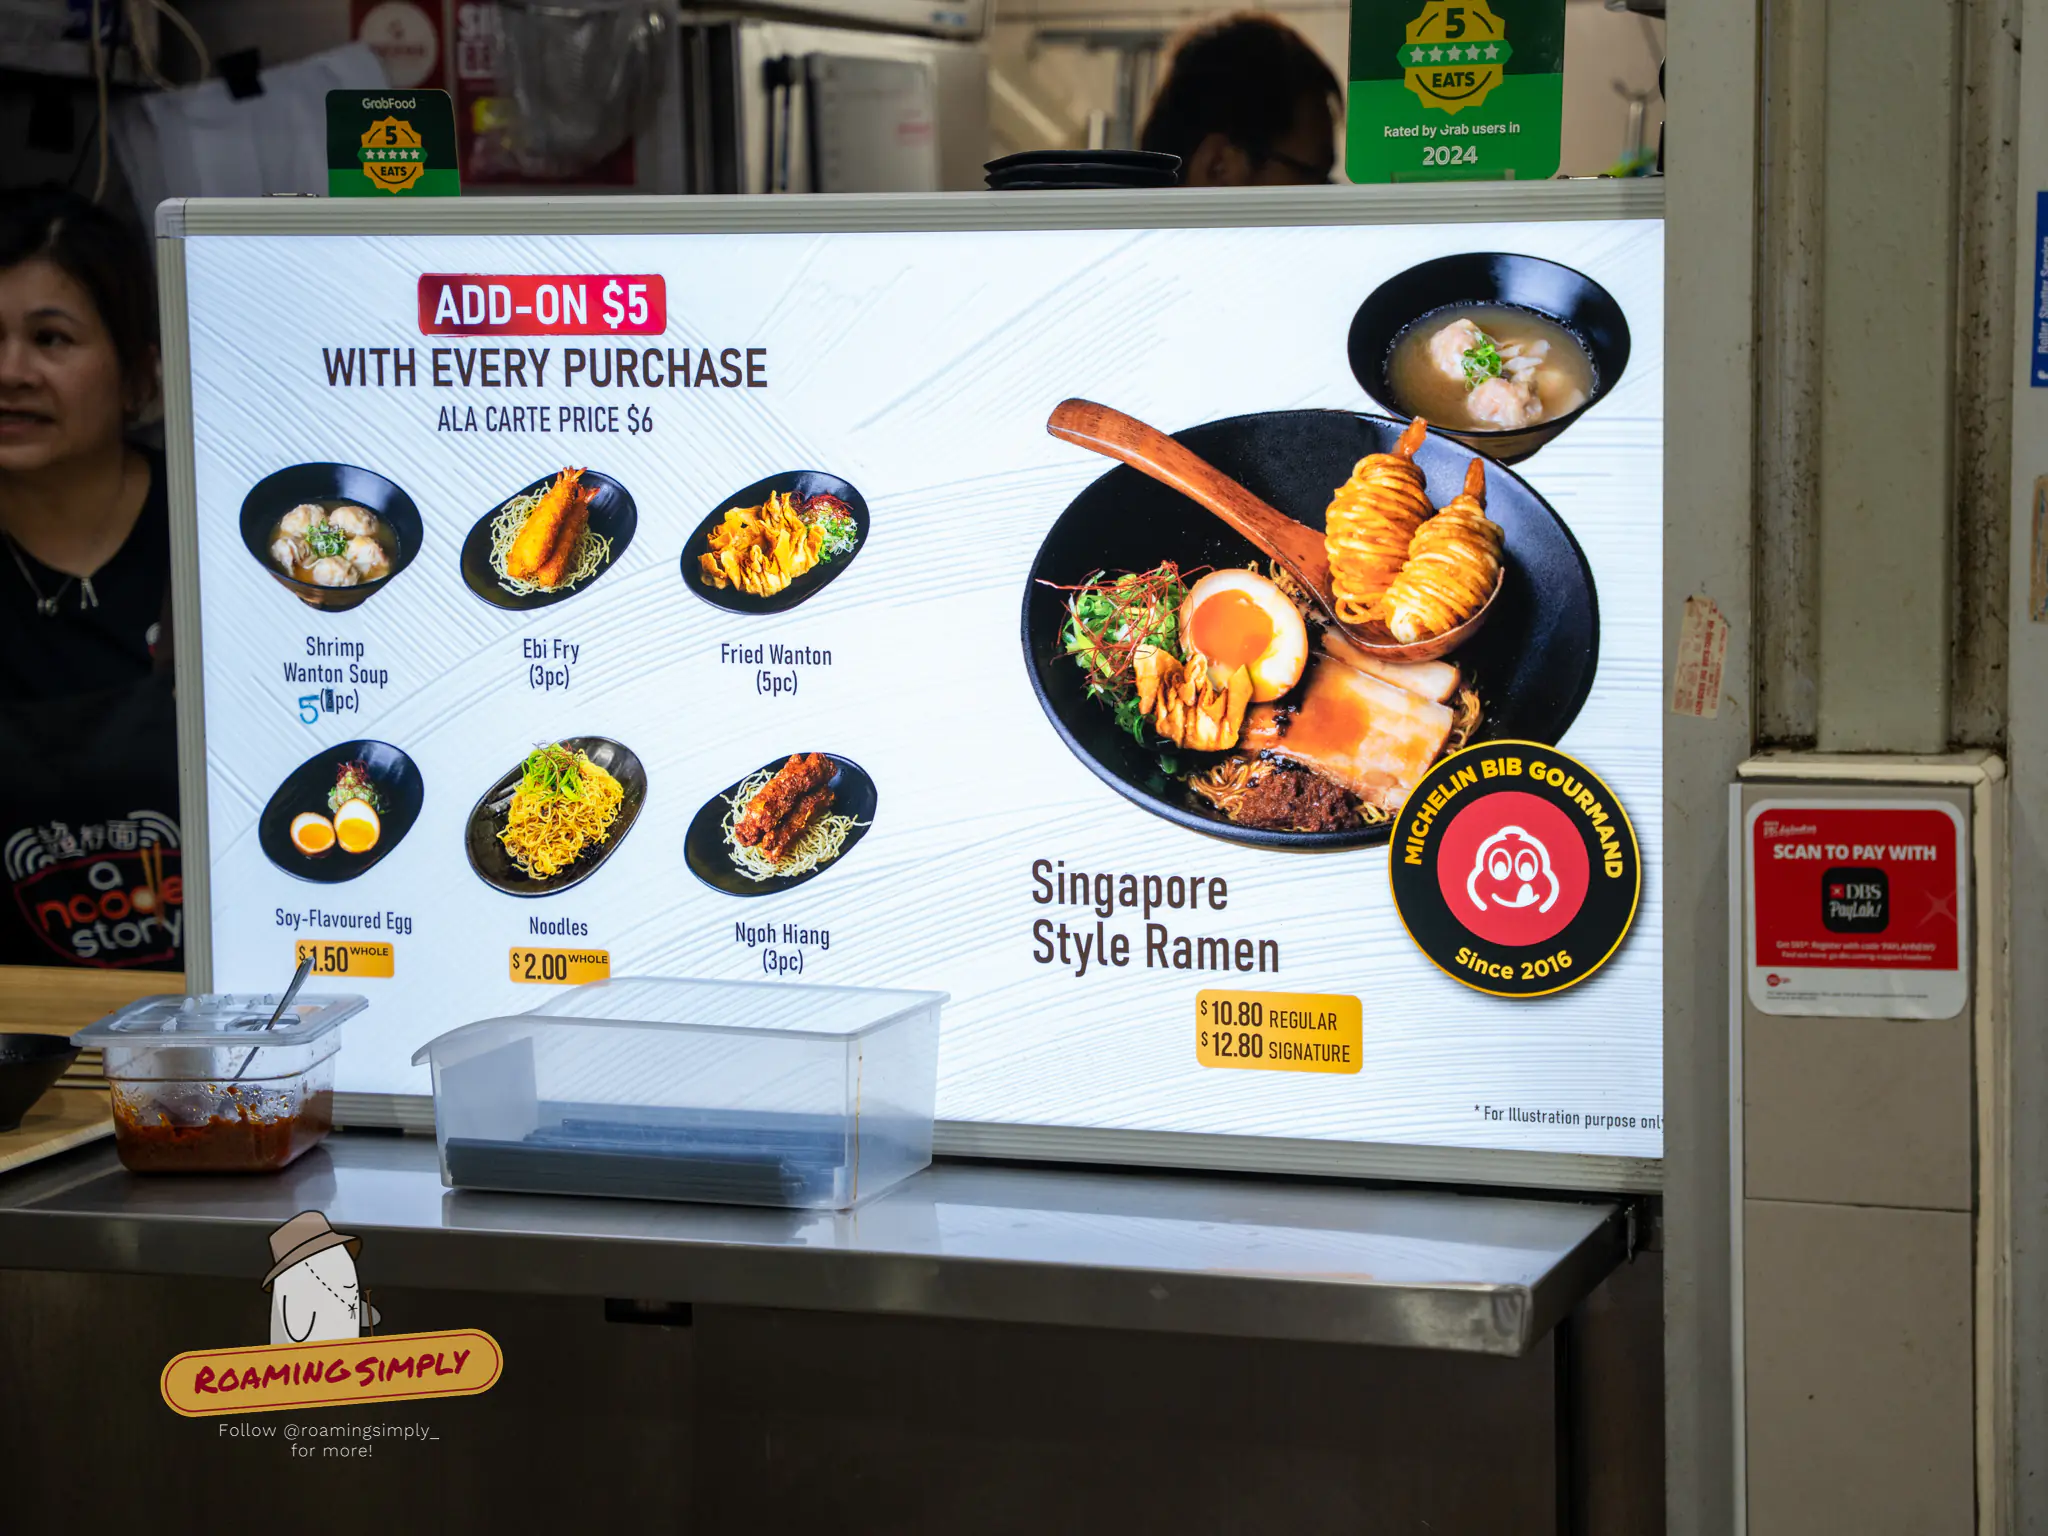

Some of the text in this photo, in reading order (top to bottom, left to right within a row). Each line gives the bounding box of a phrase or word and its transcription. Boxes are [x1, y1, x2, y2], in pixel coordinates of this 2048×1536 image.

[1445, 7, 1466, 39] 5
[1432, 72, 1475, 88] EATS
[362, 97, 417, 109] GrabFood
[385, 125, 398, 145] 5
[1384, 124, 1419, 138] Rated
[1422, 124, 1437, 140] by
[1472, 123, 1506, 136] users
[1509, 121, 1521, 134] in
[1422, 145, 1478, 166] 2024
[380, 166, 407, 176] EATS
[434, 280, 649, 329] ADD-ON $5
[323, 347, 768, 388] WITH EVERY PURCHASE
[438, 404, 653, 436] ALA CARTE PRICE $6
[306, 636, 365, 662] Shrimp
[523, 638, 580, 665] Ebi Fry
[721, 643, 832, 666] Fried Wanton
[284, 662, 388, 689] Wanton Soup
[529, 665, 570, 690] (3pc)
[756, 669, 798, 697] (5pc)
[298, 694, 320, 725] 5
[319, 688, 360, 715] (pc)
[1404, 757, 1624, 879] MICHELIN BIB GOURMAND
[1773, 843, 1937, 861] SCAN TO PAY WITH
[88, 861, 123, 890] a
[1032, 858, 1228, 920] Singapore
[1846, 883, 1882, 900] DBS
[275, 908, 413, 935] Soy-Flavoured Egg
[1829, 900, 1882, 922] PayLah!
[72, 910, 182, 959] story
[529, 916, 589, 937] Noodles
[735, 922, 830, 950] Ngoh Hiang
[350, 947, 389, 956] WHOLE
[568, 954, 608, 965] WHOLE
[1032, 919, 1279, 977] Style Ramen
[763, 948, 804, 975] (3pc)
[1455, 947, 1573, 980] Since 2016
[1269, 1010, 1337, 1031] REGULAR
[1269, 1041, 1350, 1063] SIGNATURE
[1484, 1105, 1504, 1120] For
[1509, 1107, 1580, 1125] Illustration
[1585, 1113, 1636, 1130] purpose
